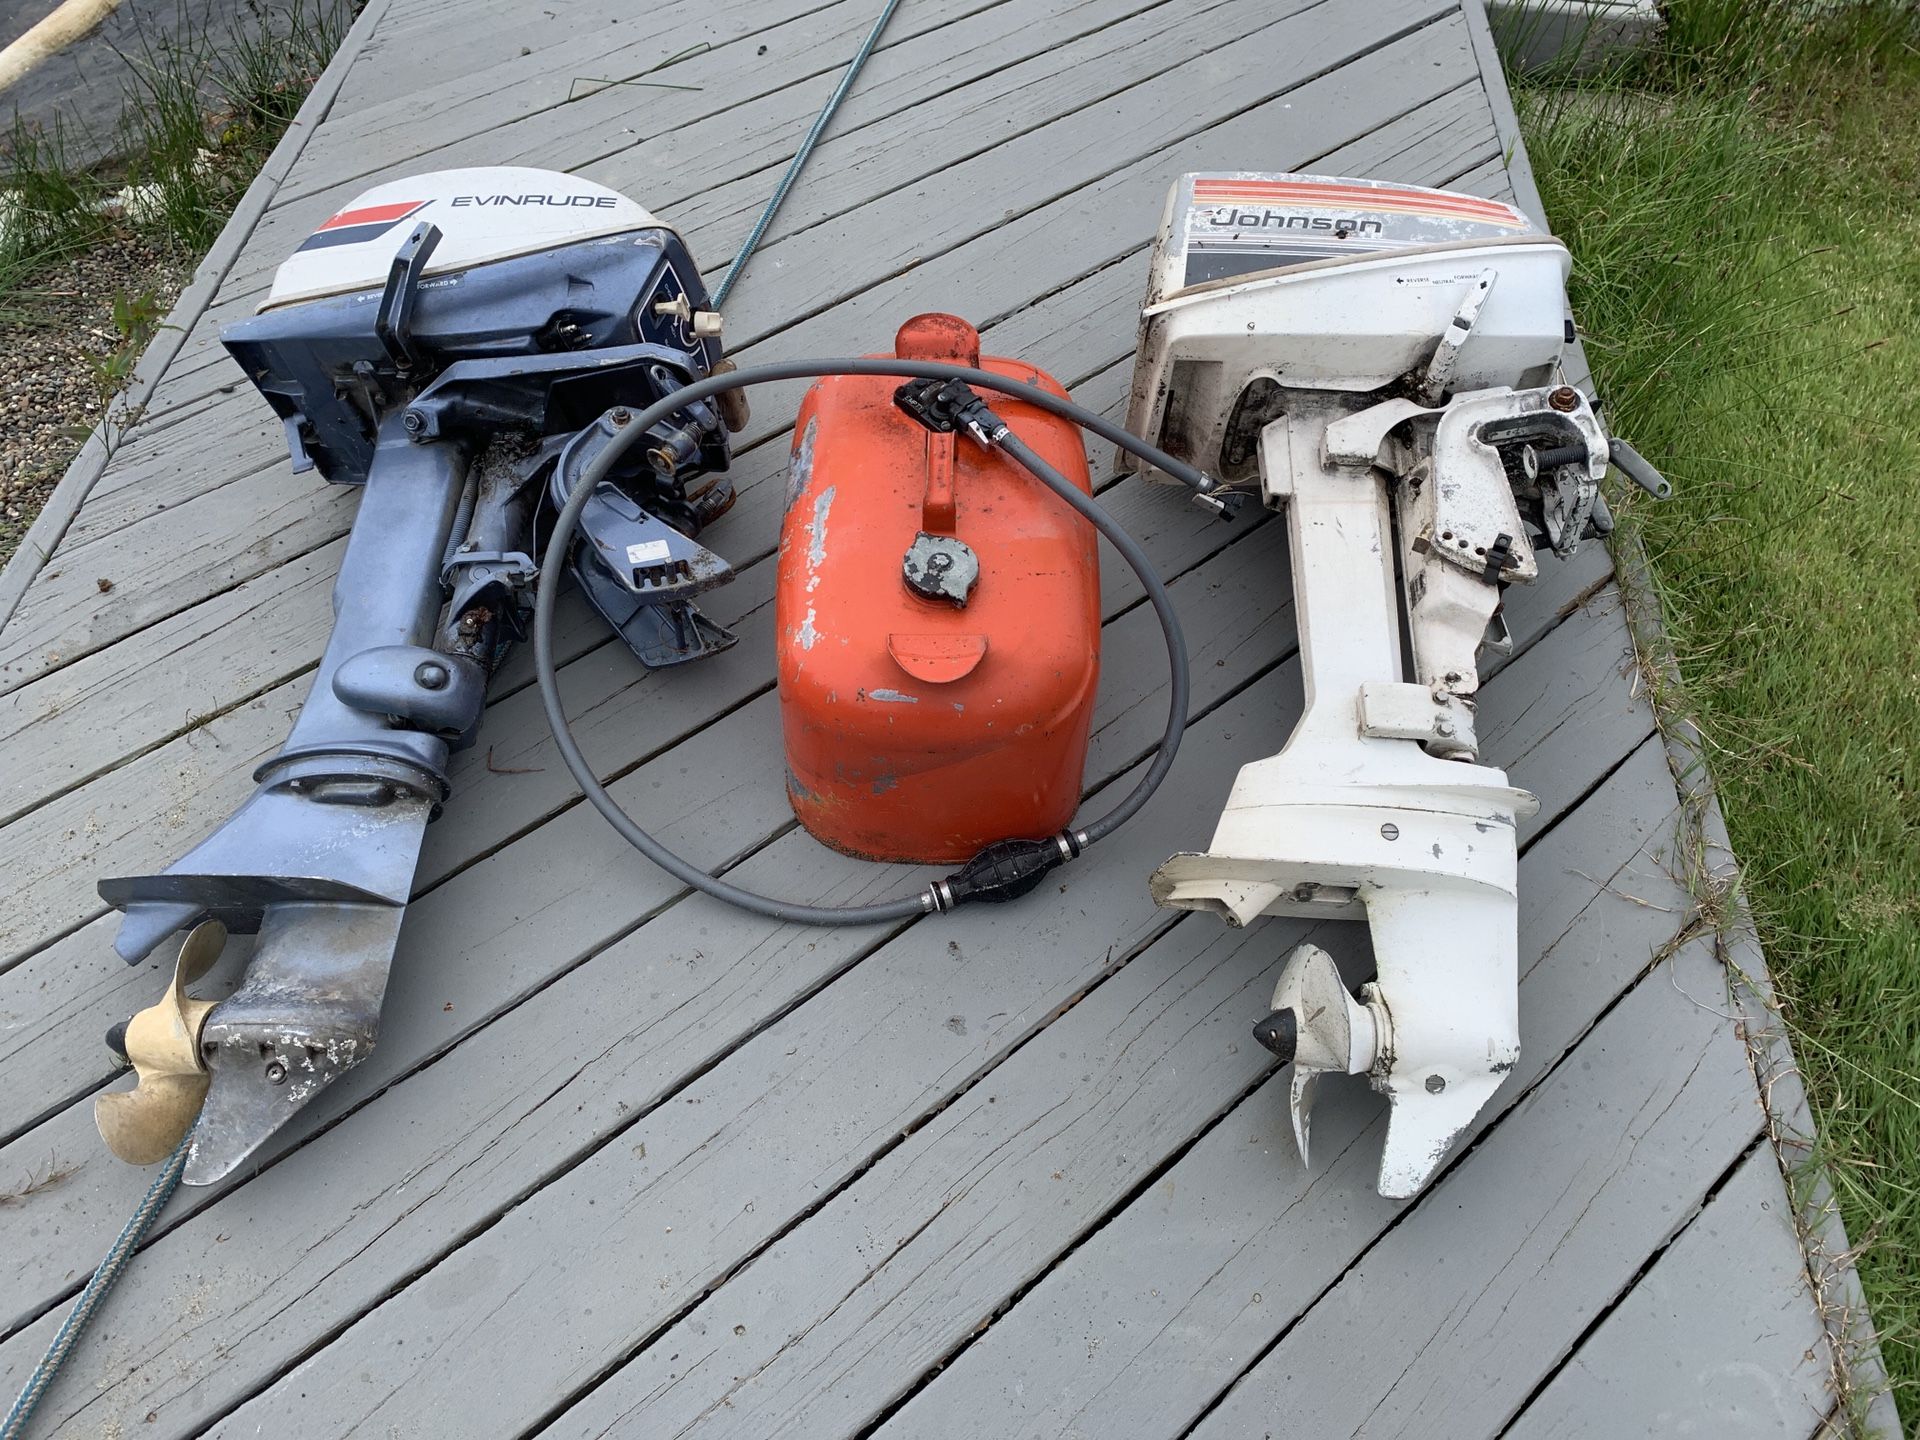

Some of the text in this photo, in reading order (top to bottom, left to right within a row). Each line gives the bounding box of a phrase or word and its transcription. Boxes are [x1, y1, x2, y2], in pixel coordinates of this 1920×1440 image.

[451, 195, 618, 208] EVINRUDE
[1210, 208, 1382, 233] Johnson
[417, 280, 449, 290] FORWARD
[903, 395, 924, 414] EMPTY
